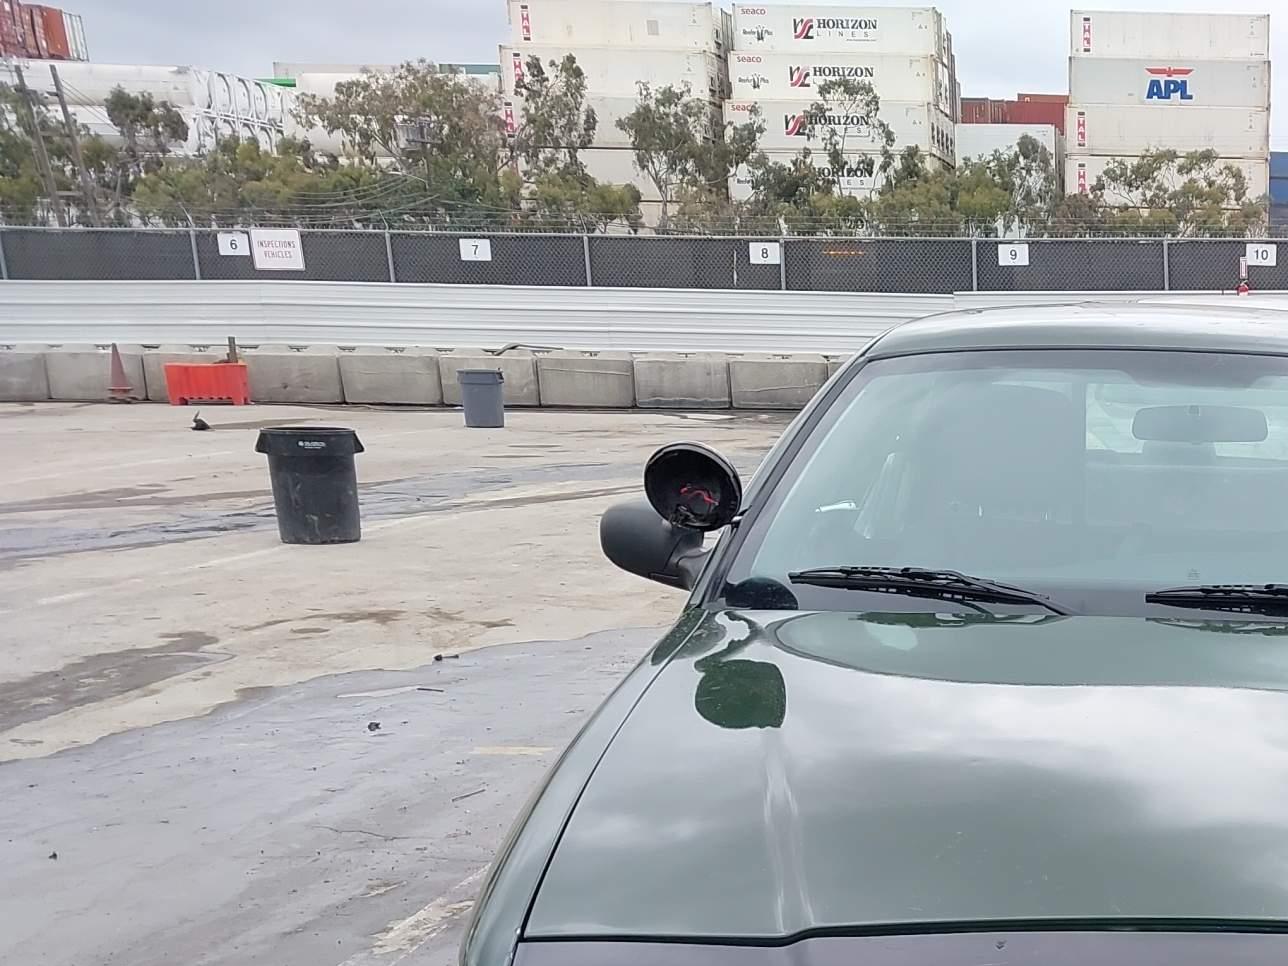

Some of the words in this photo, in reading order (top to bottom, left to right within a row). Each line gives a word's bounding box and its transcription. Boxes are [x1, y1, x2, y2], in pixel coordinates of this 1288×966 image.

[521, 12, 531, 40] TAL
[816, 18, 877, 29] HORIZON
[1083, 23, 1091, 48] TAL
[812, 66, 874, 77] HORIZON
[1146, 79, 1194, 100] APL
[1078, 117, 1086, 142] TAL
[230, 239, 238, 250] 6
[257, 240, 296, 249] INSPECTIONS
[471, 244, 479, 256] 7
[264, 250, 293, 259] VEHICLES
[761, 247, 769, 259] 8
[1009, 249, 1017, 261] 9
[1253, 249, 1269, 261] 10
